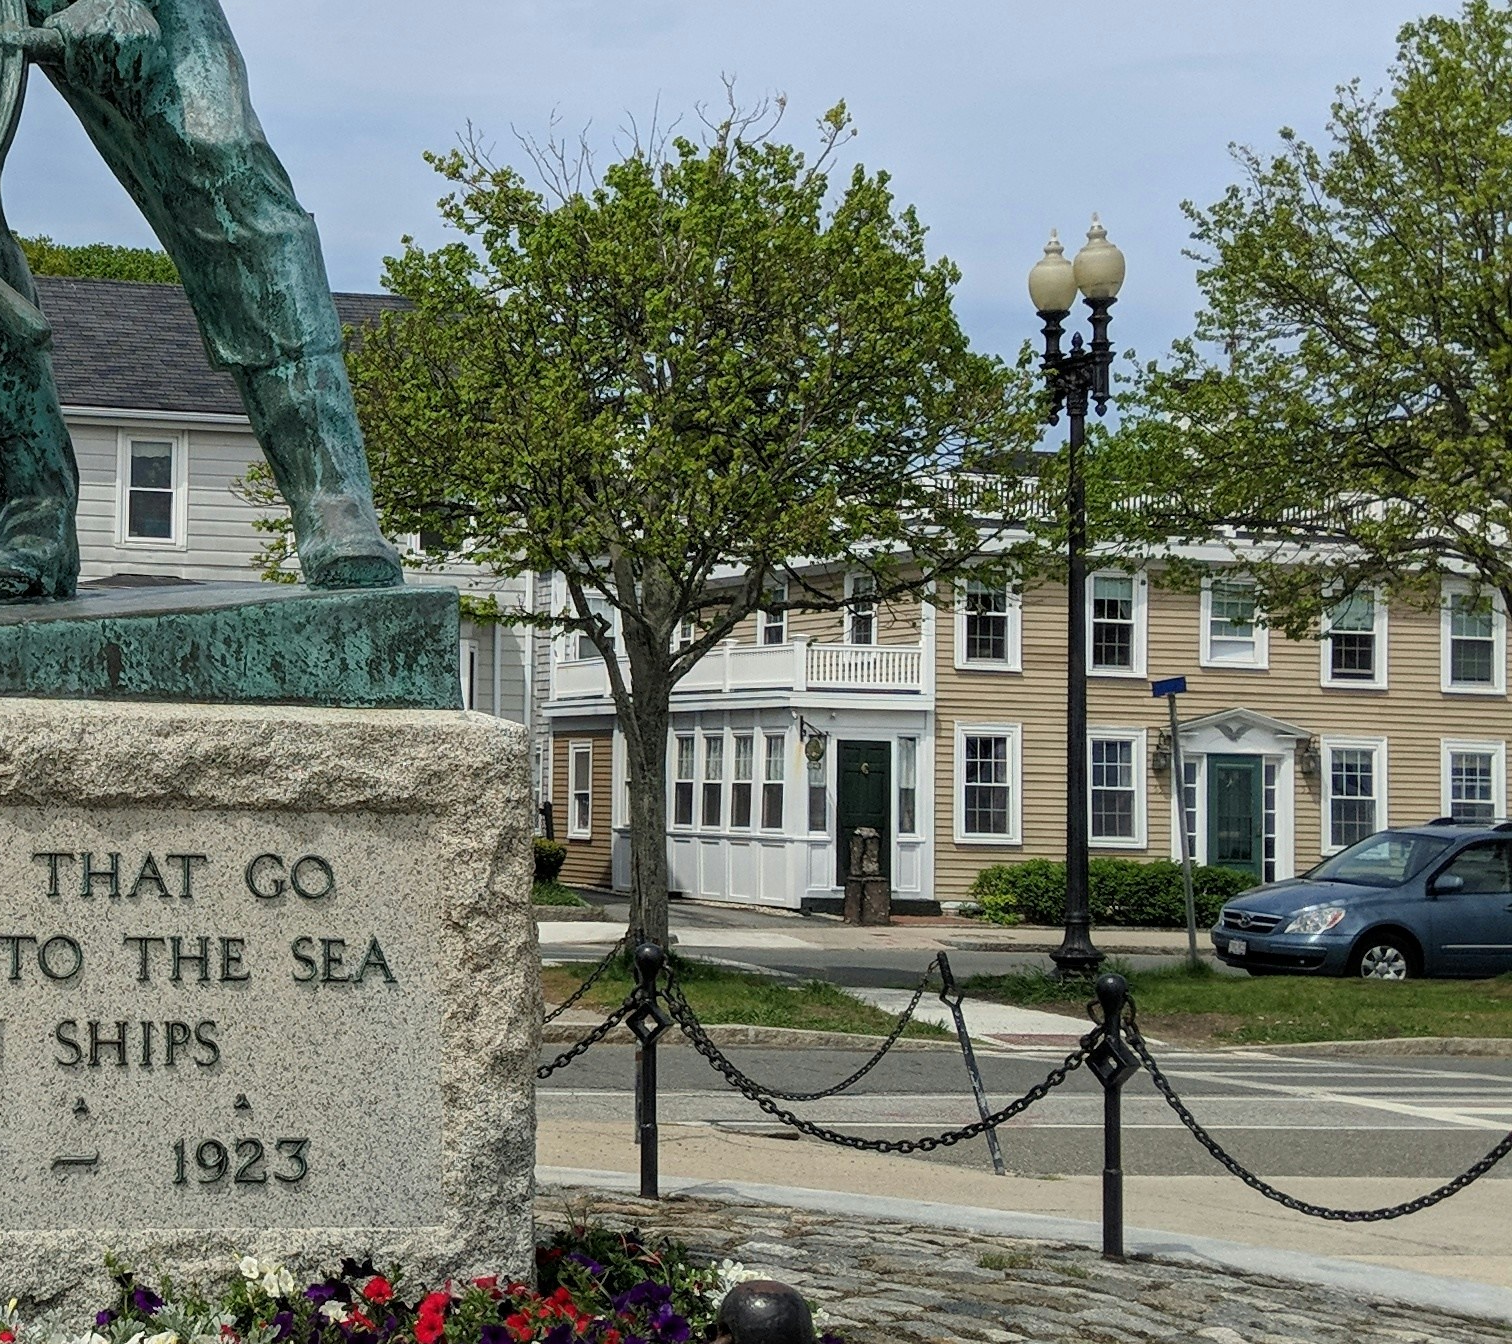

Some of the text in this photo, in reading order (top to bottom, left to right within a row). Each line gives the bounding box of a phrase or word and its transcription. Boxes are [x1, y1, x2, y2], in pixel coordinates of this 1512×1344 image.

[32, 851, 208, 900] THAT
[244, 852, 336, 902] GO
[123, 936, 252, 985] THE
[291, 936, 398, 986] SEA
[55, 1019, 221, 1069] SHIPS
[172, 1137, 310, 1188] 1923
